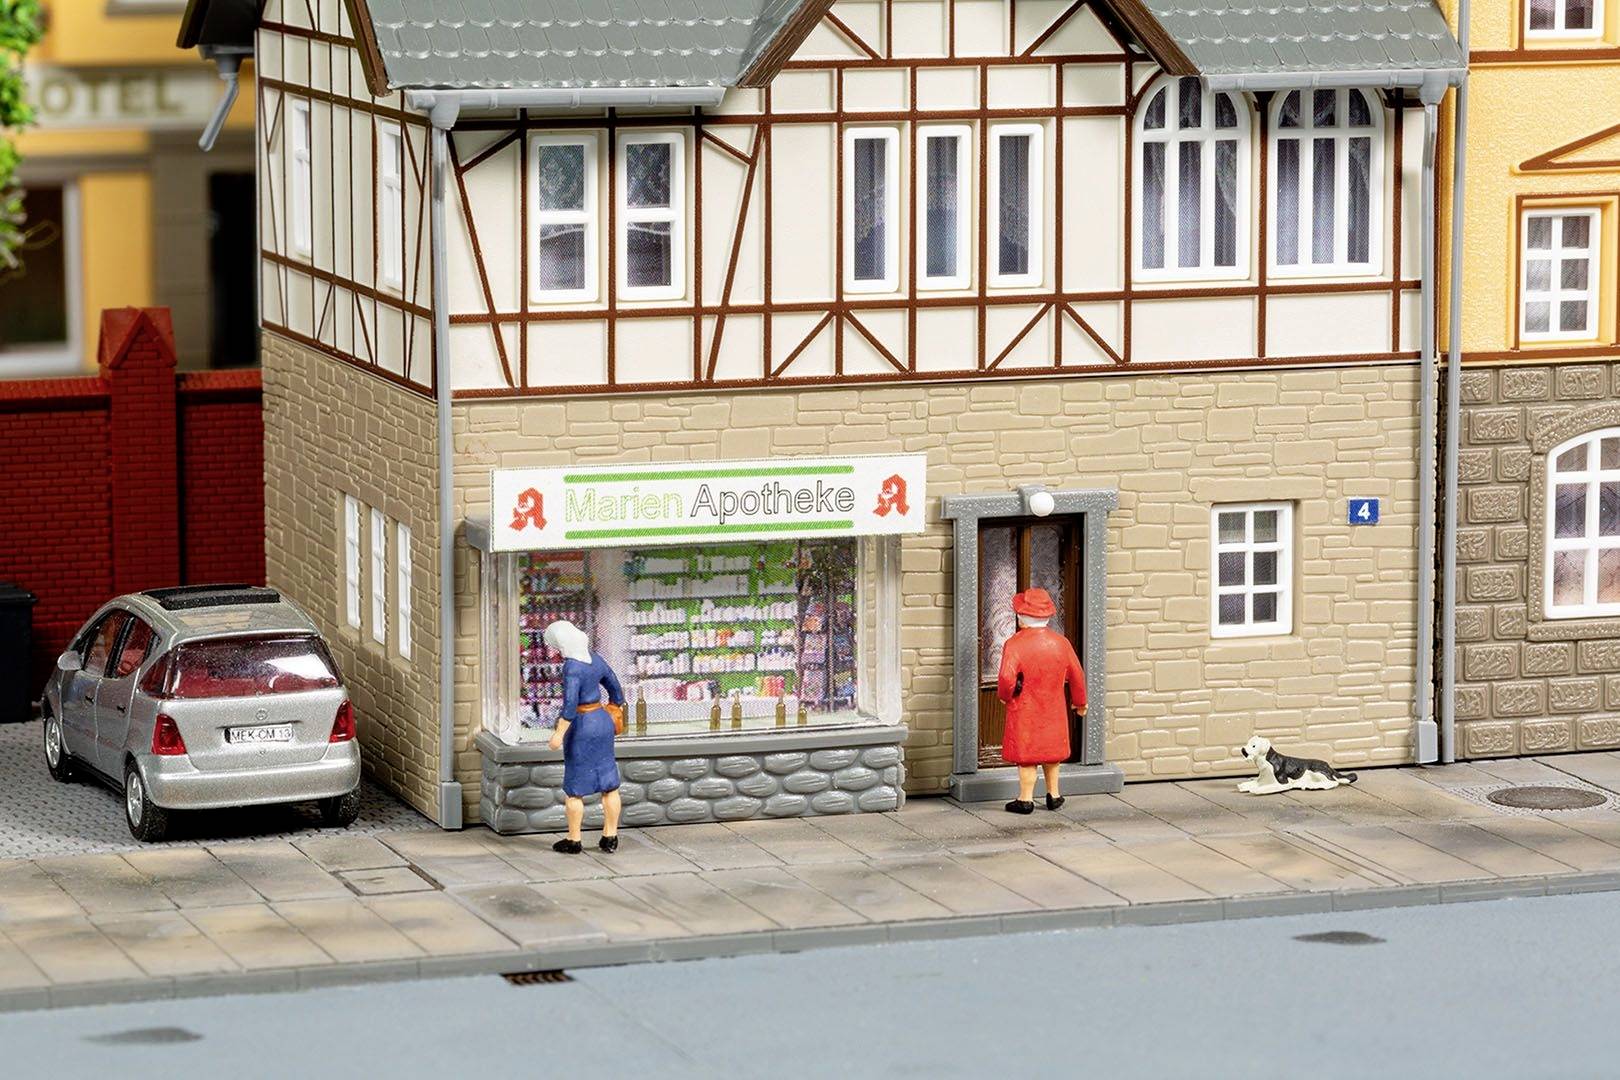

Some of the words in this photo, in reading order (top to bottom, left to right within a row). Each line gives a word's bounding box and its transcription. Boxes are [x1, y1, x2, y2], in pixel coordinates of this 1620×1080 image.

[40, 74, 184, 116] OTEL
[564, 486, 683, 523] Marien
[690, 480, 855, 524] Apotheke
[1357, 502, 1371, 520] 4
